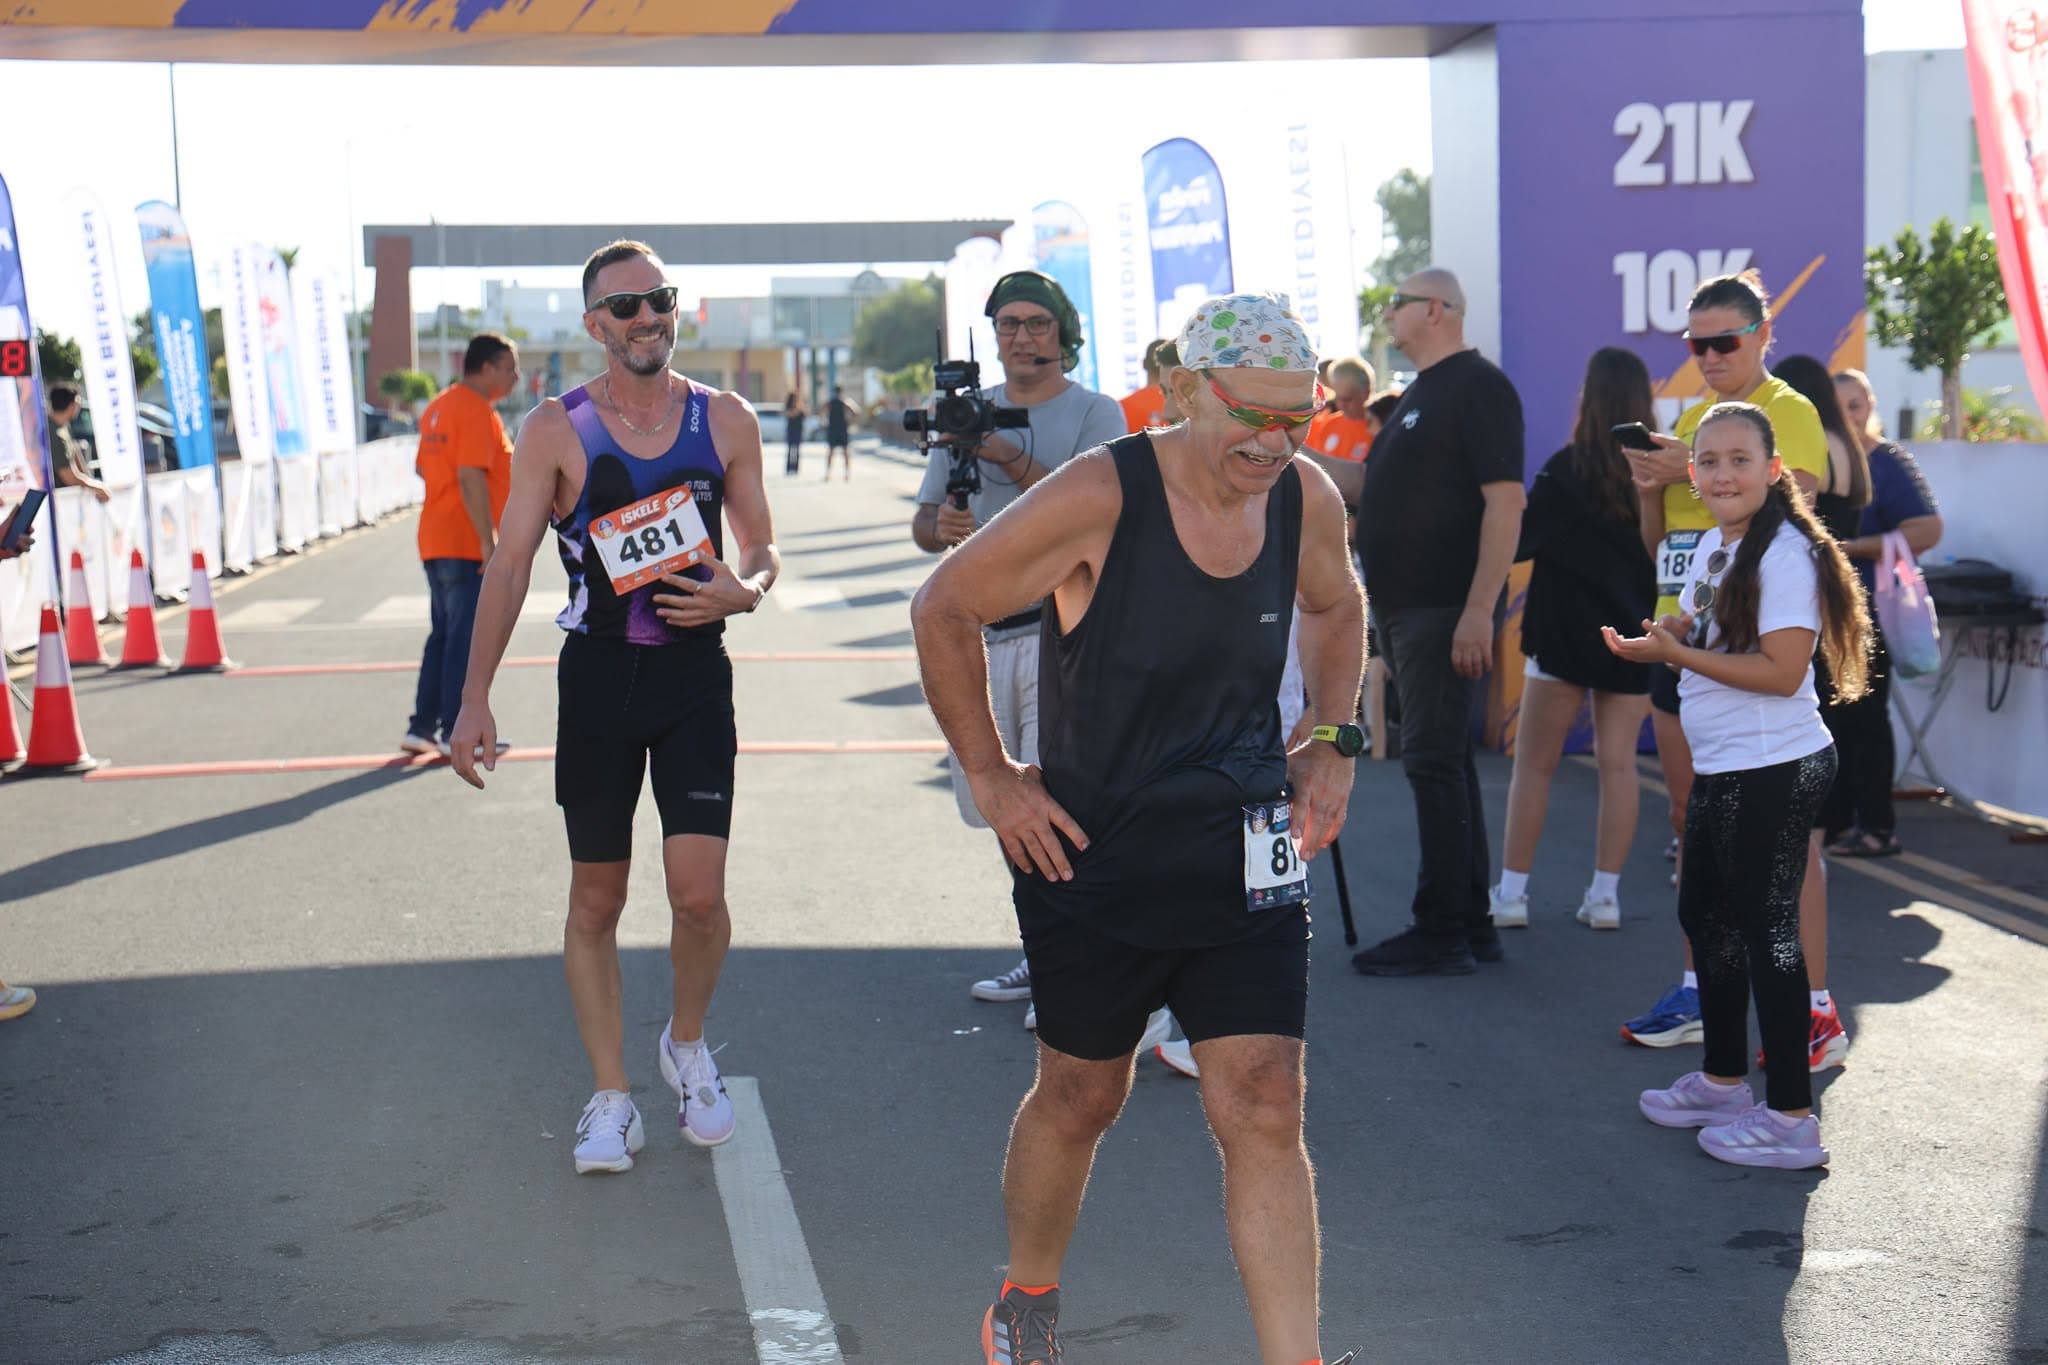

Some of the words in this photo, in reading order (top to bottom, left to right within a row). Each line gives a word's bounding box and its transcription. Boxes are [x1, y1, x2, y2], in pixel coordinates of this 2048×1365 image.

[1612, 98, 1755, 187] 21K
[1, 340, 26, 376] 8
[690, 400, 700, 433] soar
[619, 518, 685, 563] 481
